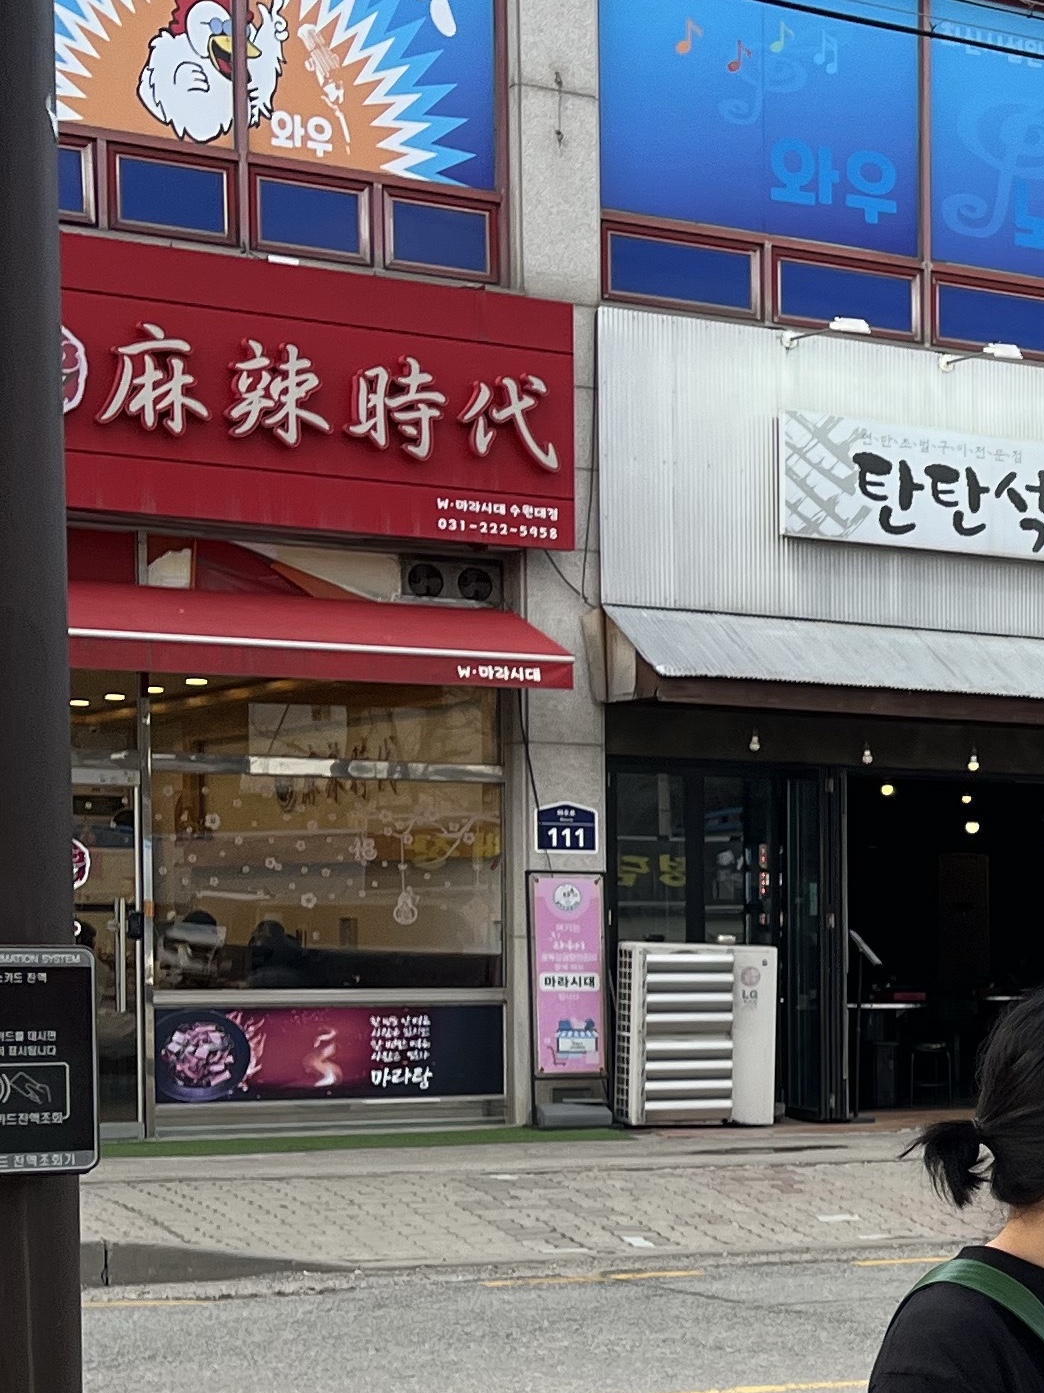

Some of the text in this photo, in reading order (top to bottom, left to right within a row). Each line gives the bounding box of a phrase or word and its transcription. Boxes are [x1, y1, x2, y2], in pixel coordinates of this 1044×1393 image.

[271, 110, 333, 157] 와우
[769, 137, 898, 225] 와우
[97, 322, 561, 472] 麻辣時代
[437, 517, 558, 540] 031-222-5958
[547, 827, 585, 848] 111
[41, 954, 81, 963] SYSTEM
